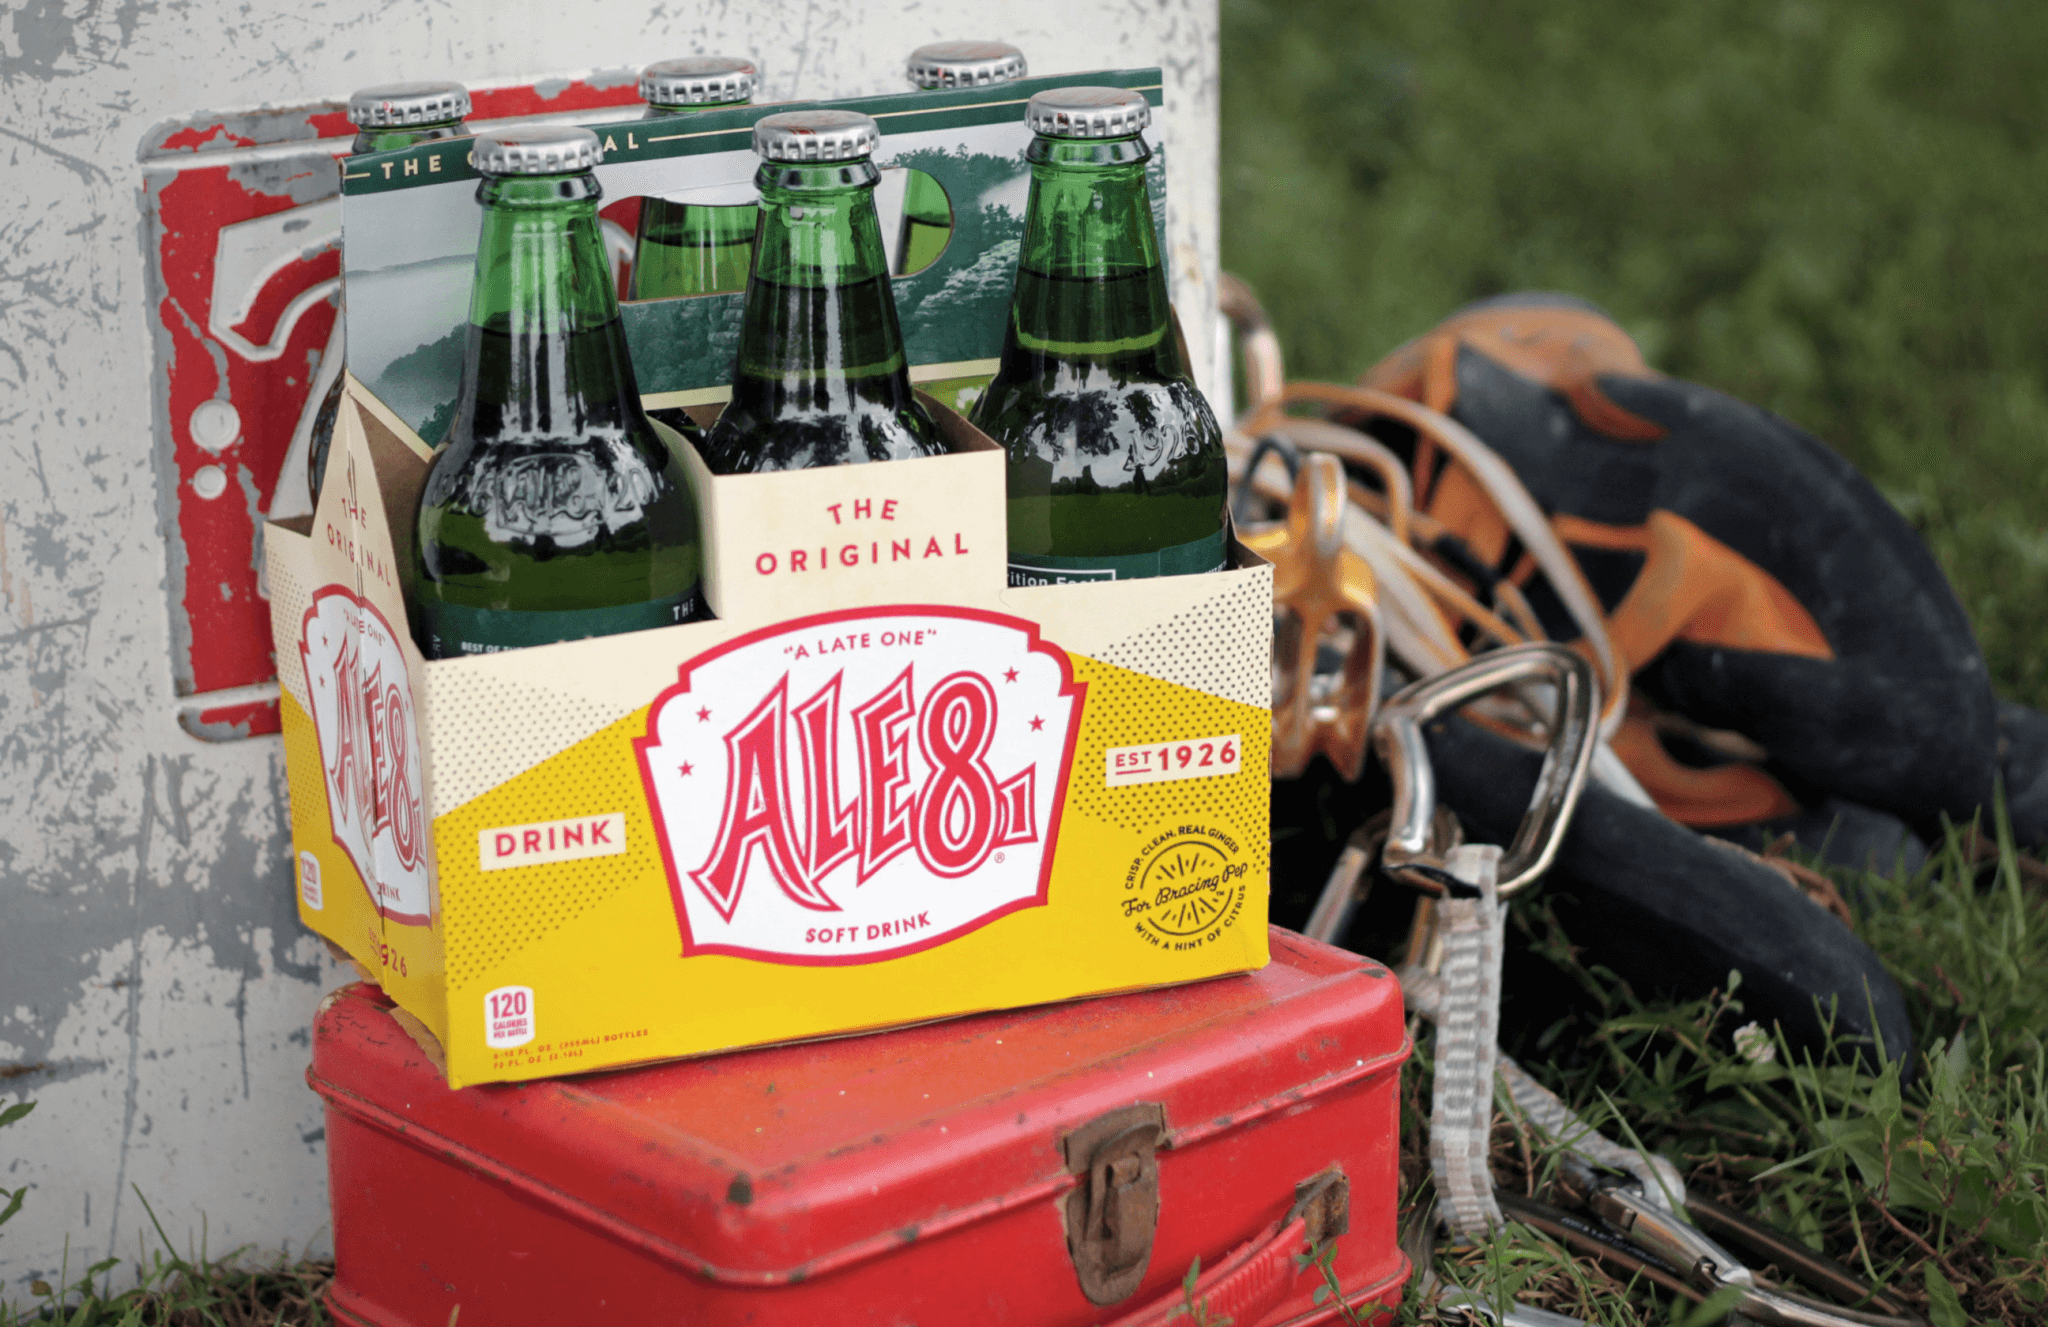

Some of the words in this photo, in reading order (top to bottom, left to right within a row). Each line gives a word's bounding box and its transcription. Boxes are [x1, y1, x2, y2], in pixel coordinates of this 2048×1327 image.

[381, 154, 442, 179] THE
[341, 498, 366, 530] THE
[827, 498, 898, 525] THE
[326, 522, 391, 587] ORIGINAL
[755, 532, 969, 575] ORIGINAL
[1008, 571, 1048, 587] ition
[460, 641, 483, 654] BEST
[818, 633, 870, 655] LATE
[880, 628, 937, 647] ONE”
[1115, 751, 1152, 768] EST
[1158, 740, 1236, 771] 1926
[495, 819, 612, 857] DRINK
[1124, 857, 1144, 890] CRISP,
[1178, 825, 1206, 836] REAL
[1208, 828, 1240, 855] GINGER
[1121, 897, 1151, 917] For
[1155, 875, 1219, 906] Bracing
[1222, 862, 1248, 883] Pep
[805, 927, 860, 944] SOFT
[866, 911, 932, 940] DRINK
[1135, 922, 1160, 946] WITH
[1162, 942, 1170, 950] A
[1174, 937, 1203, 951] HINT
[1207, 927, 1222, 942] OF
[1224, 885, 1246, 927] CITRUS
[489, 991, 527, 1019] 120
[604, 1028, 649, 1043] BOTTLES
